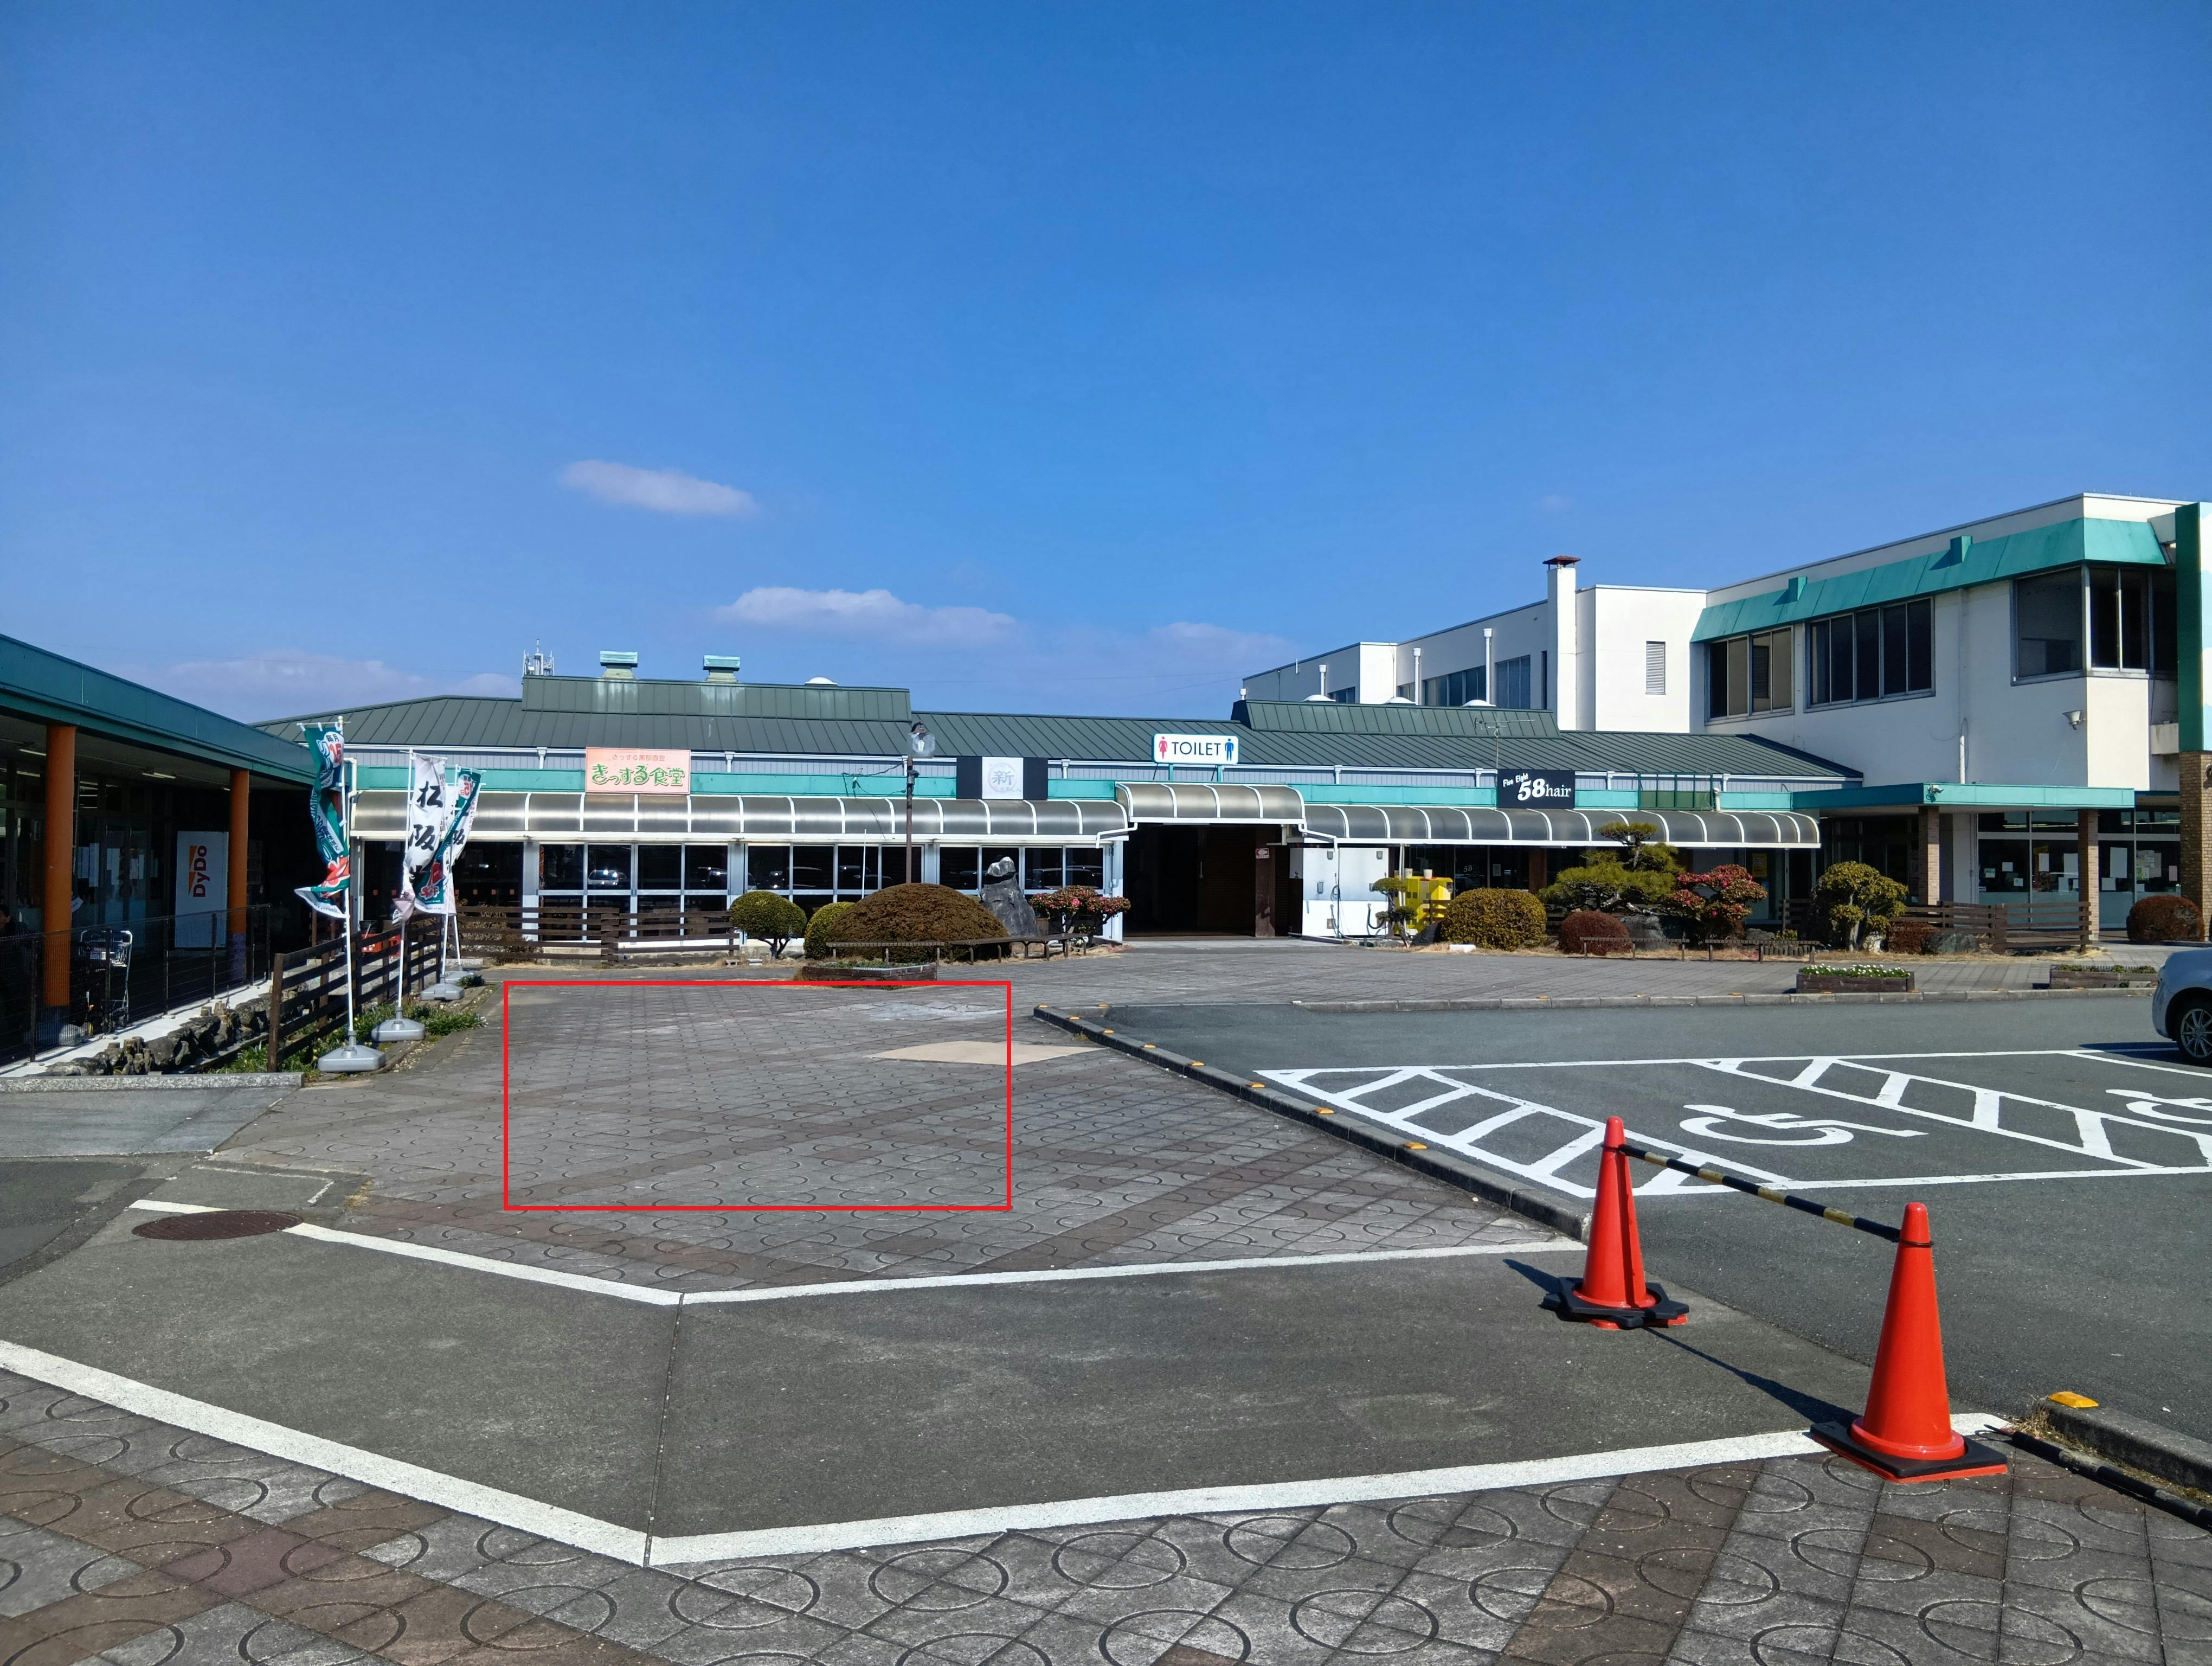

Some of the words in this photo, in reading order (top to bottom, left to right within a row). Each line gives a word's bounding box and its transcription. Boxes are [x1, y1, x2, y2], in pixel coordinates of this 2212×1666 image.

[1172, 741, 1221, 756] TOILET
[592, 764, 685, 787] きっする食堂
[992, 770, 1015, 785] 新
[1503, 779, 1514, 787] Five
[1515, 772, 1528, 783] Eight
[193, 845, 210, 898] DyDo
[1463, 864, 1472, 873] 58
